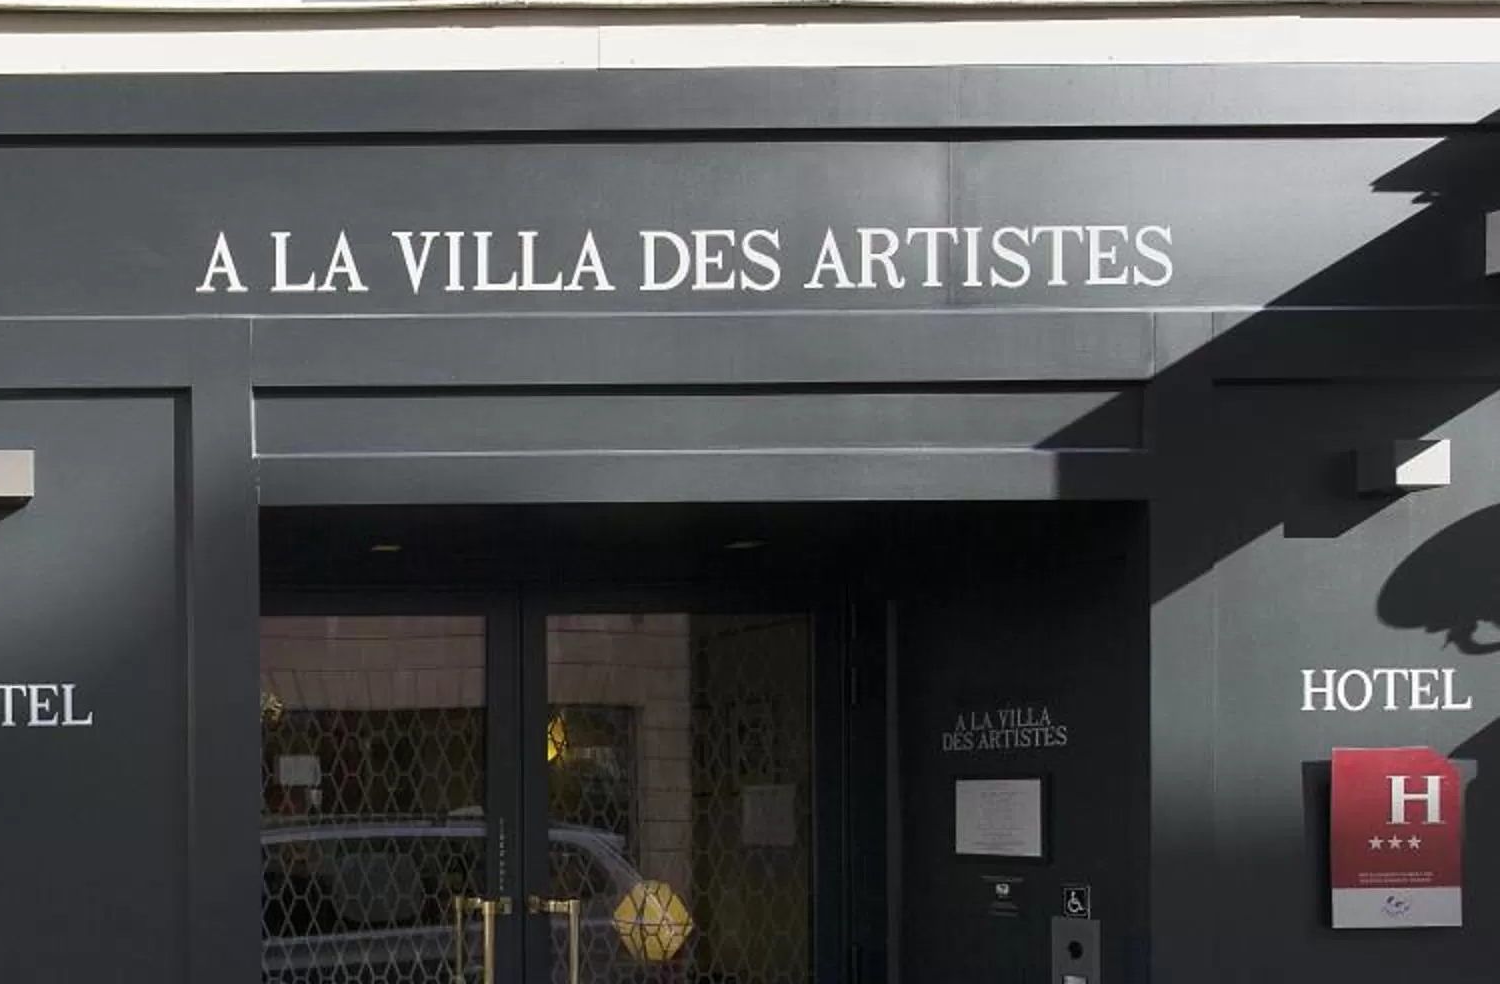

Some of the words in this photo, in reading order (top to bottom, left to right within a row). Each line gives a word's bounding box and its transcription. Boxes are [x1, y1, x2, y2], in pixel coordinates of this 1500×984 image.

[195, 231, 248, 293] A
[270, 231, 369, 293] LA
[391, 230, 616, 293] VILLA
[639, 228, 782, 292] DES
[803, 224, 1174, 290] ARTISTES
[1301, 668, 1473, 712] HOTEL
[942, 729, 975, 752] DES
[976, 724, 1068, 749] ARTISTES
[955, 713, 967, 731] A
[971, 711, 993, 732] LA
[996, 706, 1051, 728] VILLA
[1386, 775, 1447, 824] H
